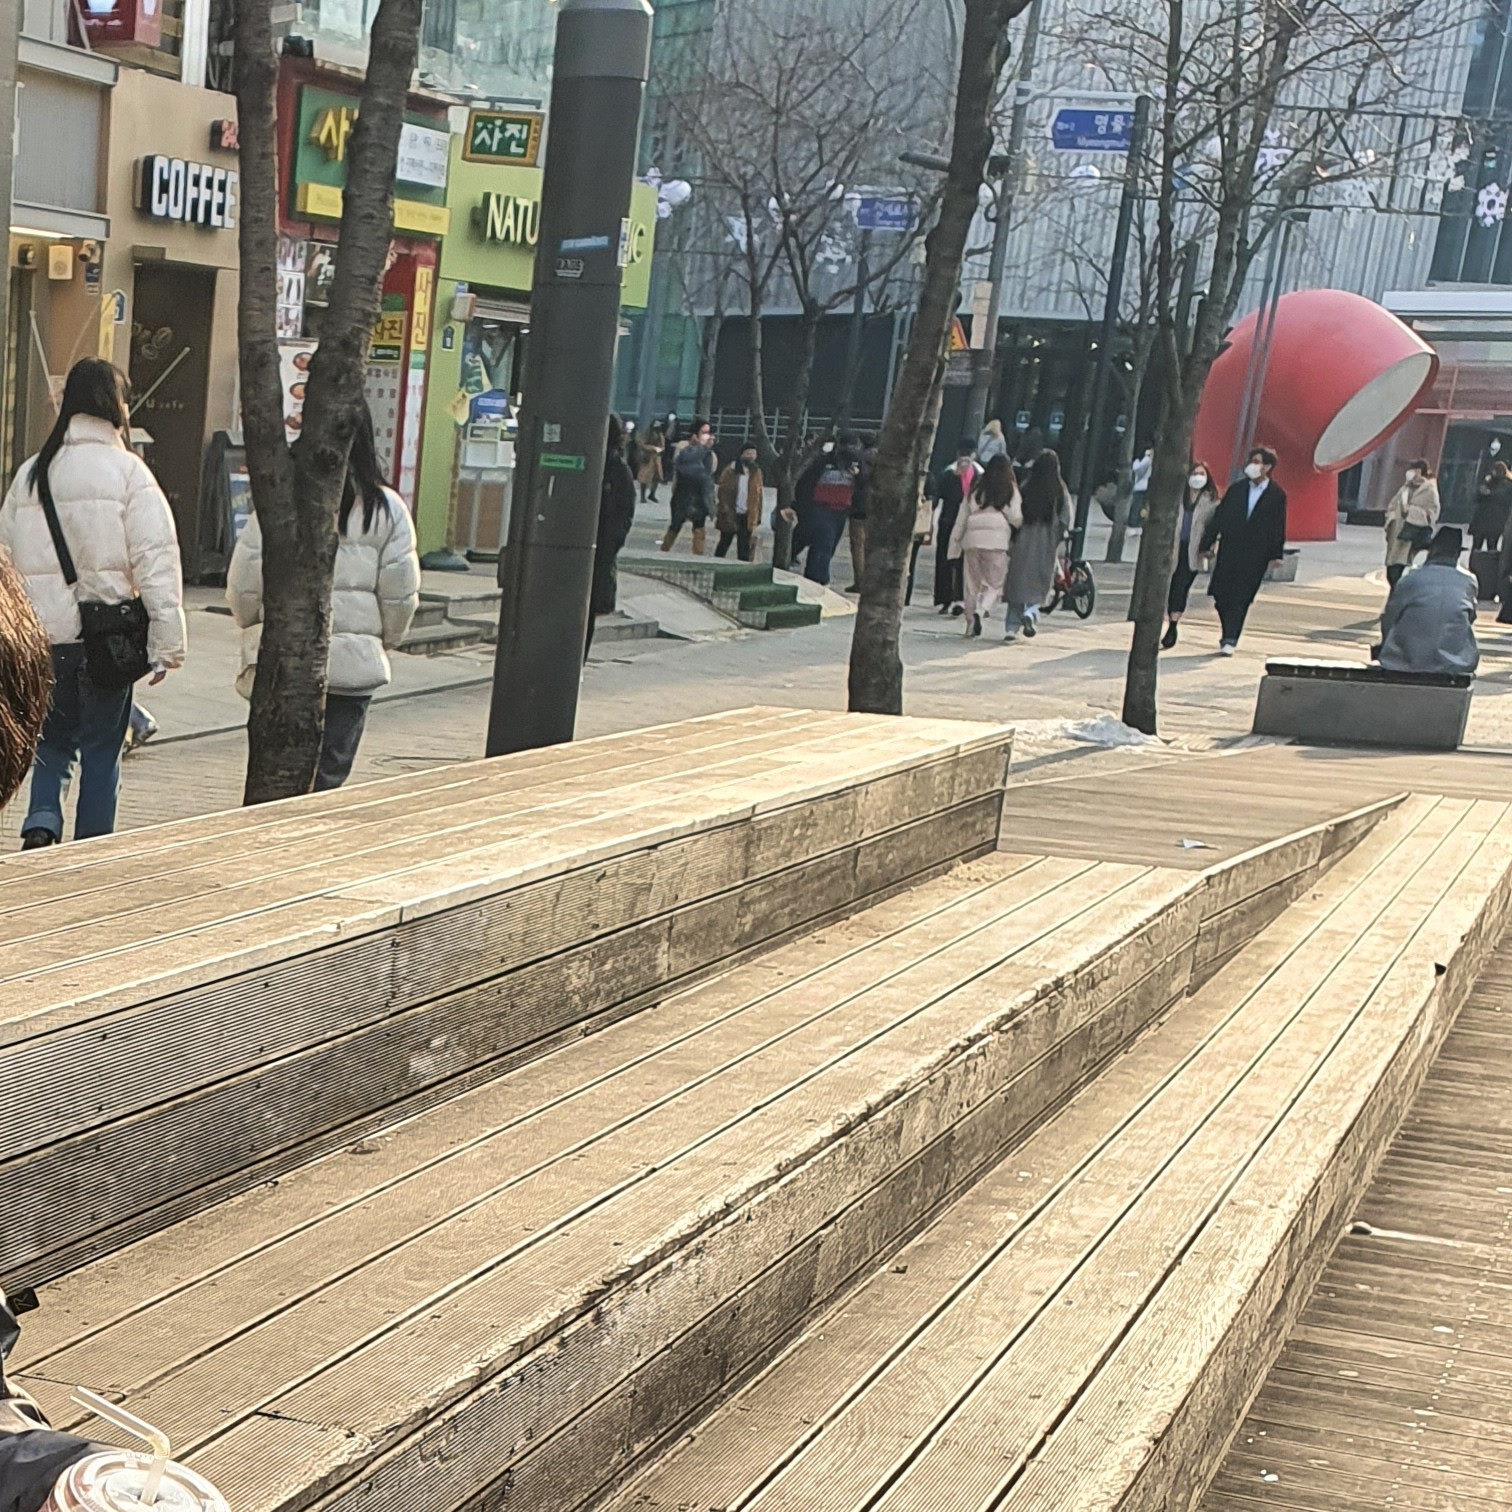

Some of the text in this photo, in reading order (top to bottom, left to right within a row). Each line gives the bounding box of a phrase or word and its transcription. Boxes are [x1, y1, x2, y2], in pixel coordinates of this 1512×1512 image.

[320, 106, 359, 161] 사
[474, 119, 529, 154] 사진
[152, 155, 239, 229] COFFEE
[415, 271, 432, 345] 사진
